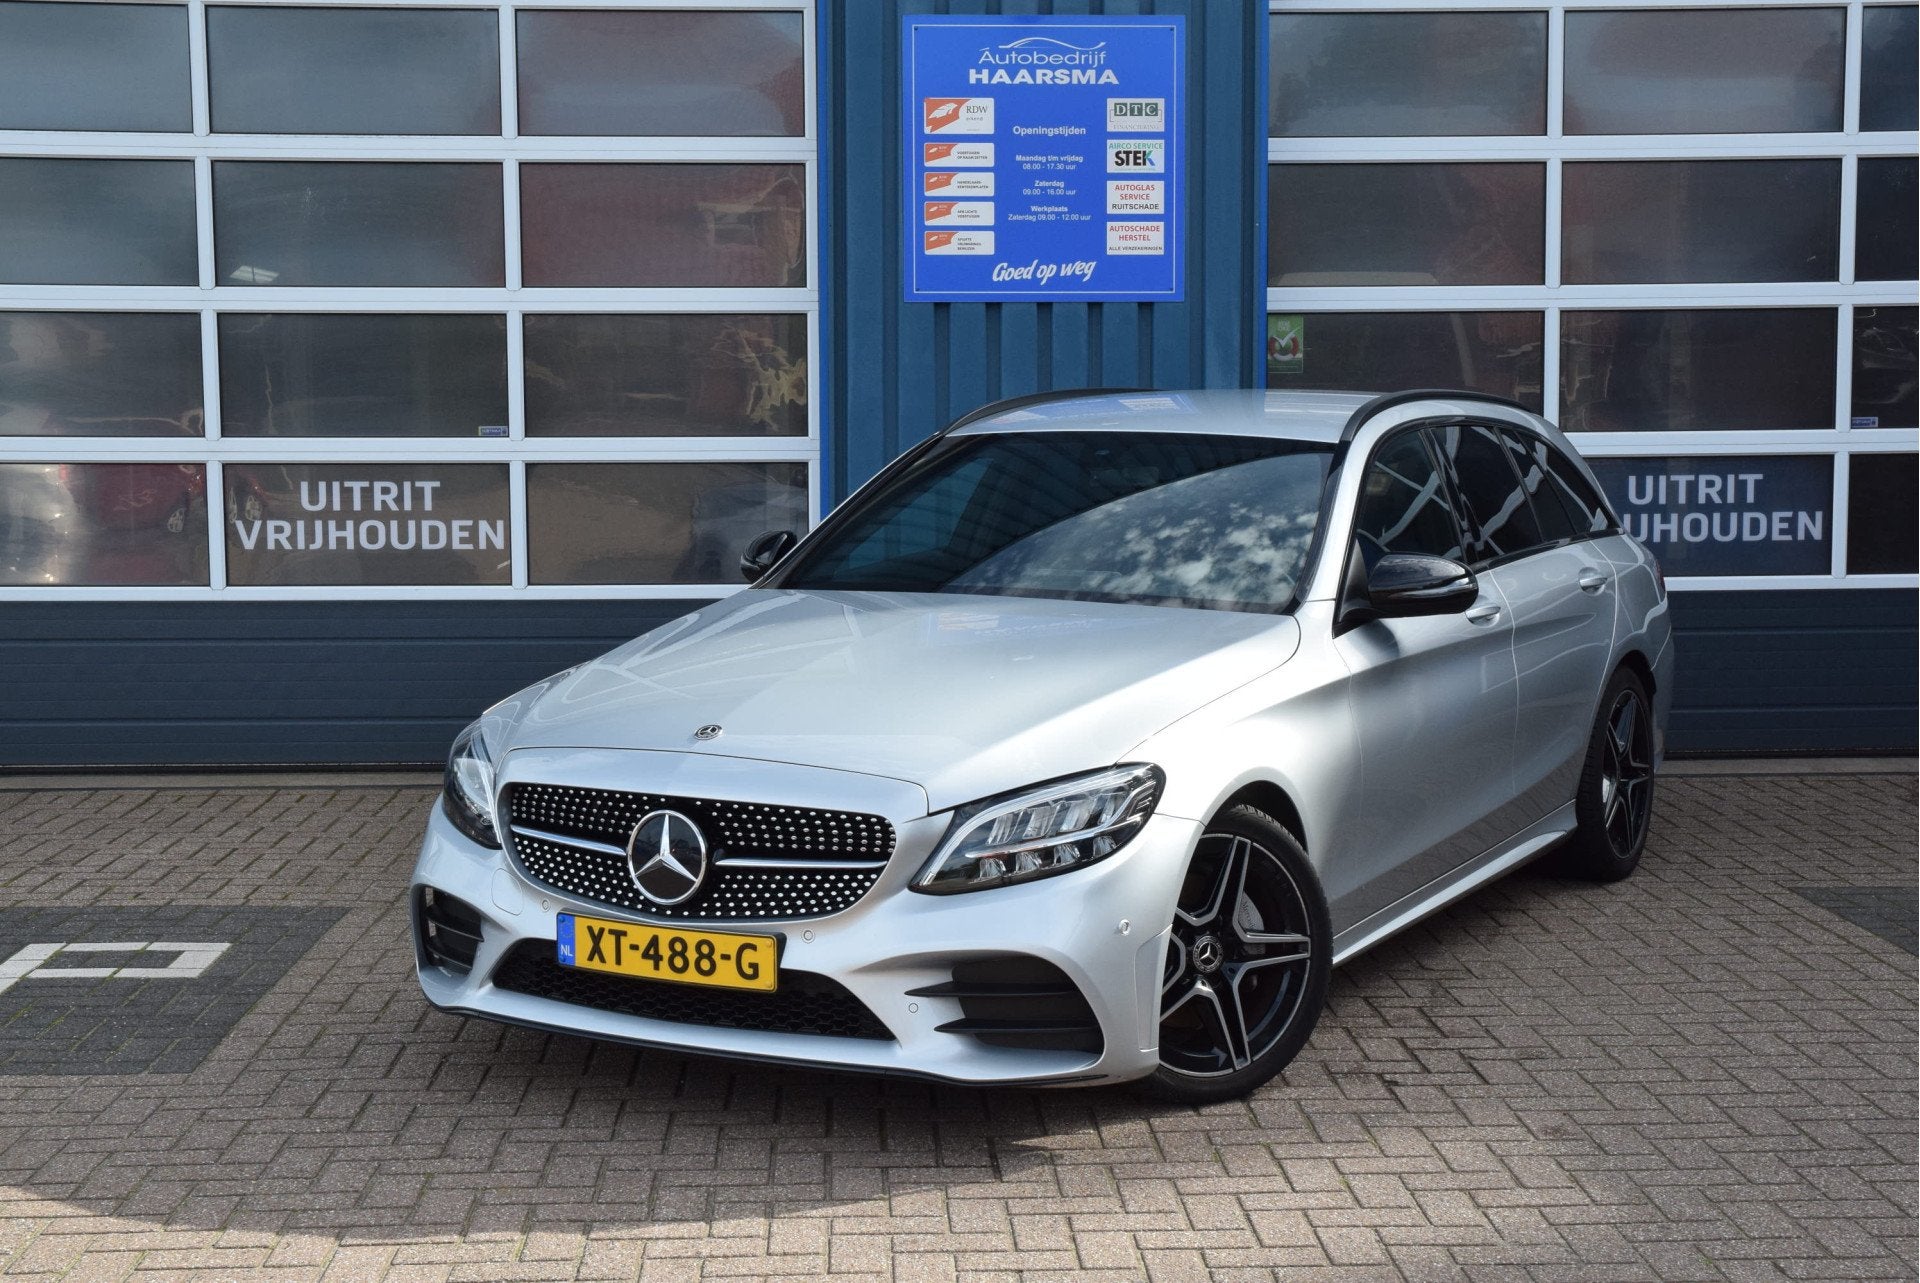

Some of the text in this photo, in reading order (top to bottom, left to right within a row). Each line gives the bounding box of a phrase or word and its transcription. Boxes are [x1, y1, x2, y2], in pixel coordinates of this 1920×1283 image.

[978, 50, 1107, 68] Autobedrijf
[969, 69, 1120, 85] HAARSMA
[966, 105, 988, 114] RDW
[1115, 103, 1157, 116] DTC
[1012, 125, 1087, 137] Openingstijden
[1015, 154, 1047, 163] Maandag
[1060, 154, 1084, 163] vrijdag
[1114, 150, 1156, 167] STEK
[1034, 180, 1065, 188] Zaterdag
[1022, 188, 1041, 196] 09.00
[1119, 193, 1151, 201] SERVICE
[1030, 205, 1069, 214] Werkplaats
[1008, 213, 1037, 222] Zaterdag
[1037, 213, 1056, 221] 09.00
[1061, 213, 1080, 221] 12.00
[1118, 234, 1152, 242] HERSTEL
[992, 259, 1097, 286] Goed op weg
[1627, 473, 1764, 505] UITRIT
[300, 481, 441, 512] UITRIT
[1623, 510, 1823, 543] IJHOUDEN
[234, 519, 505, 551] VRIJHOUDEN
[560, 943, 574, 958] NL
[586, 925, 760, 981] XT-488-G
